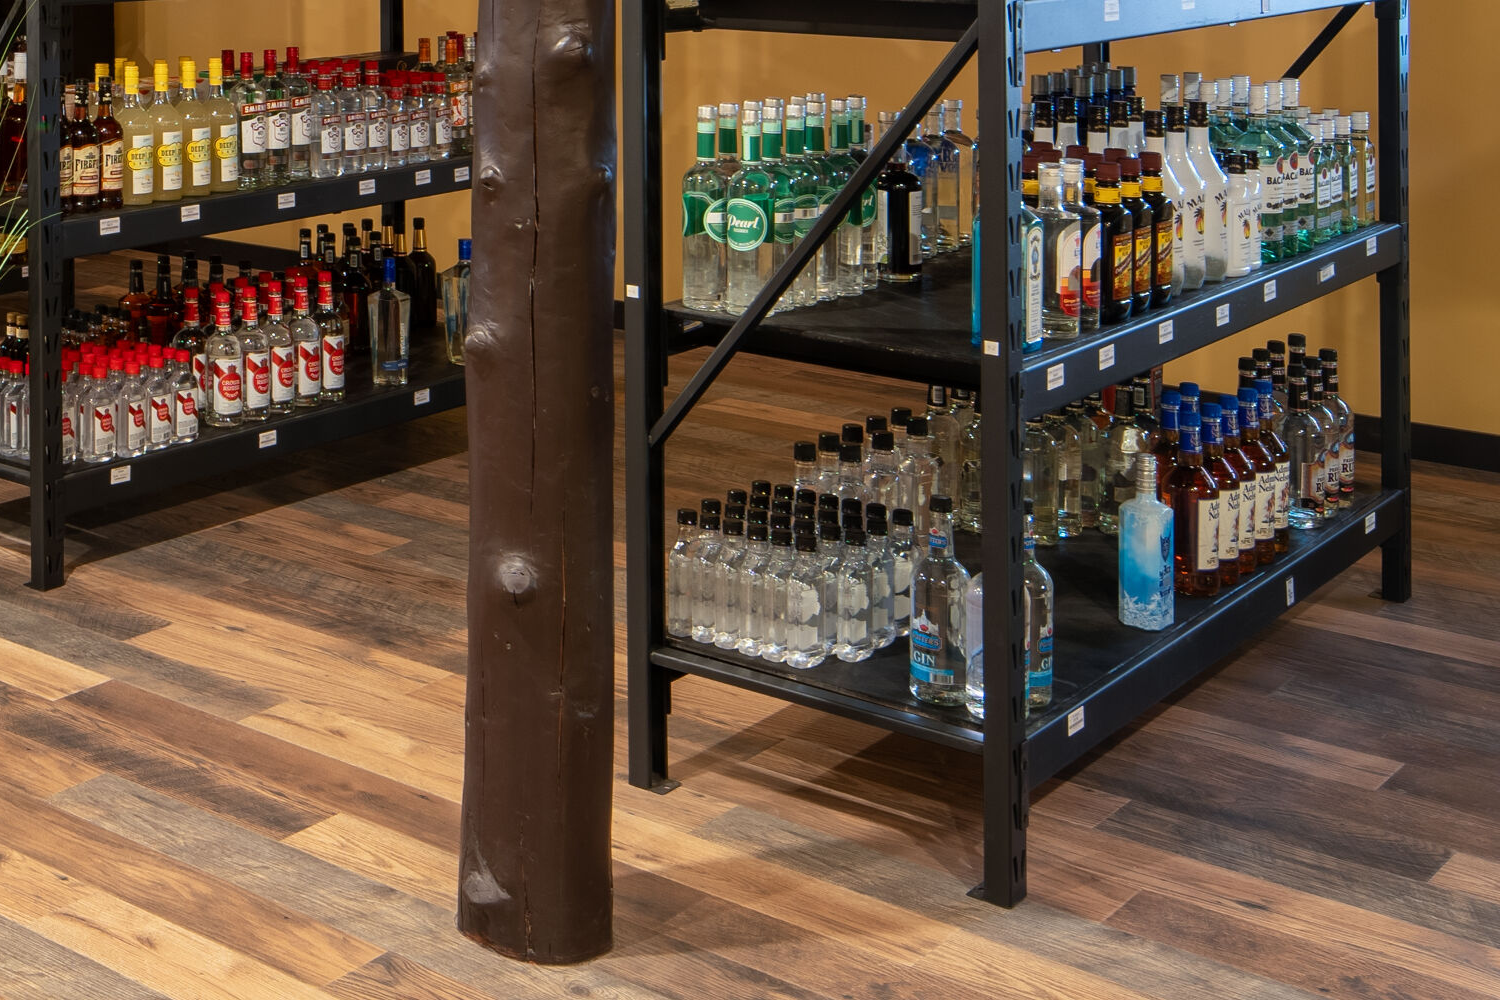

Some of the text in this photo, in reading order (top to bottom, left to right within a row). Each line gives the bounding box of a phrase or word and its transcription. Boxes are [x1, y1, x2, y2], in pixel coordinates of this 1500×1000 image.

[161, 149, 175, 157] DEEP
[191, 145, 205, 153] DEEP
[131, 152, 146, 160] DEEP
[727, 213, 760, 231] Pearl
[913, 651, 935, 666] GIN
